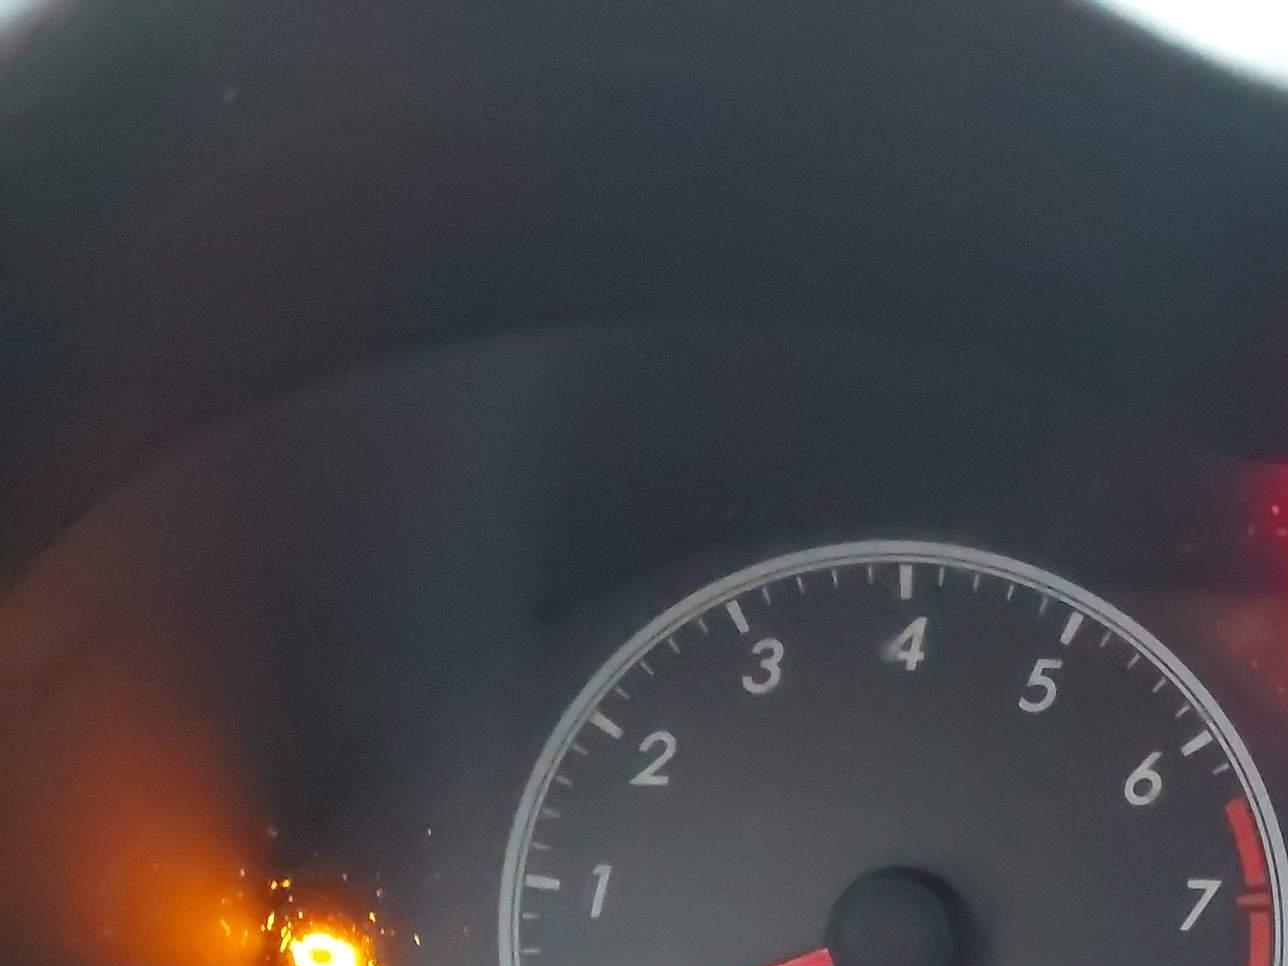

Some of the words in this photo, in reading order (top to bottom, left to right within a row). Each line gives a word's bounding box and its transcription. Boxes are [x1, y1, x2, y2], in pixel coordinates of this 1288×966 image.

[742, 638, 784, 694] 3
[890, 617, 927, 671] 4
[1018, 658, 1062, 713] 5
[630, 731, 677, 786] 2
[1124, 751, 1163, 806] 6
[590, 864, 613, 917] 1
[1180, 879, 1221, 930] 7
